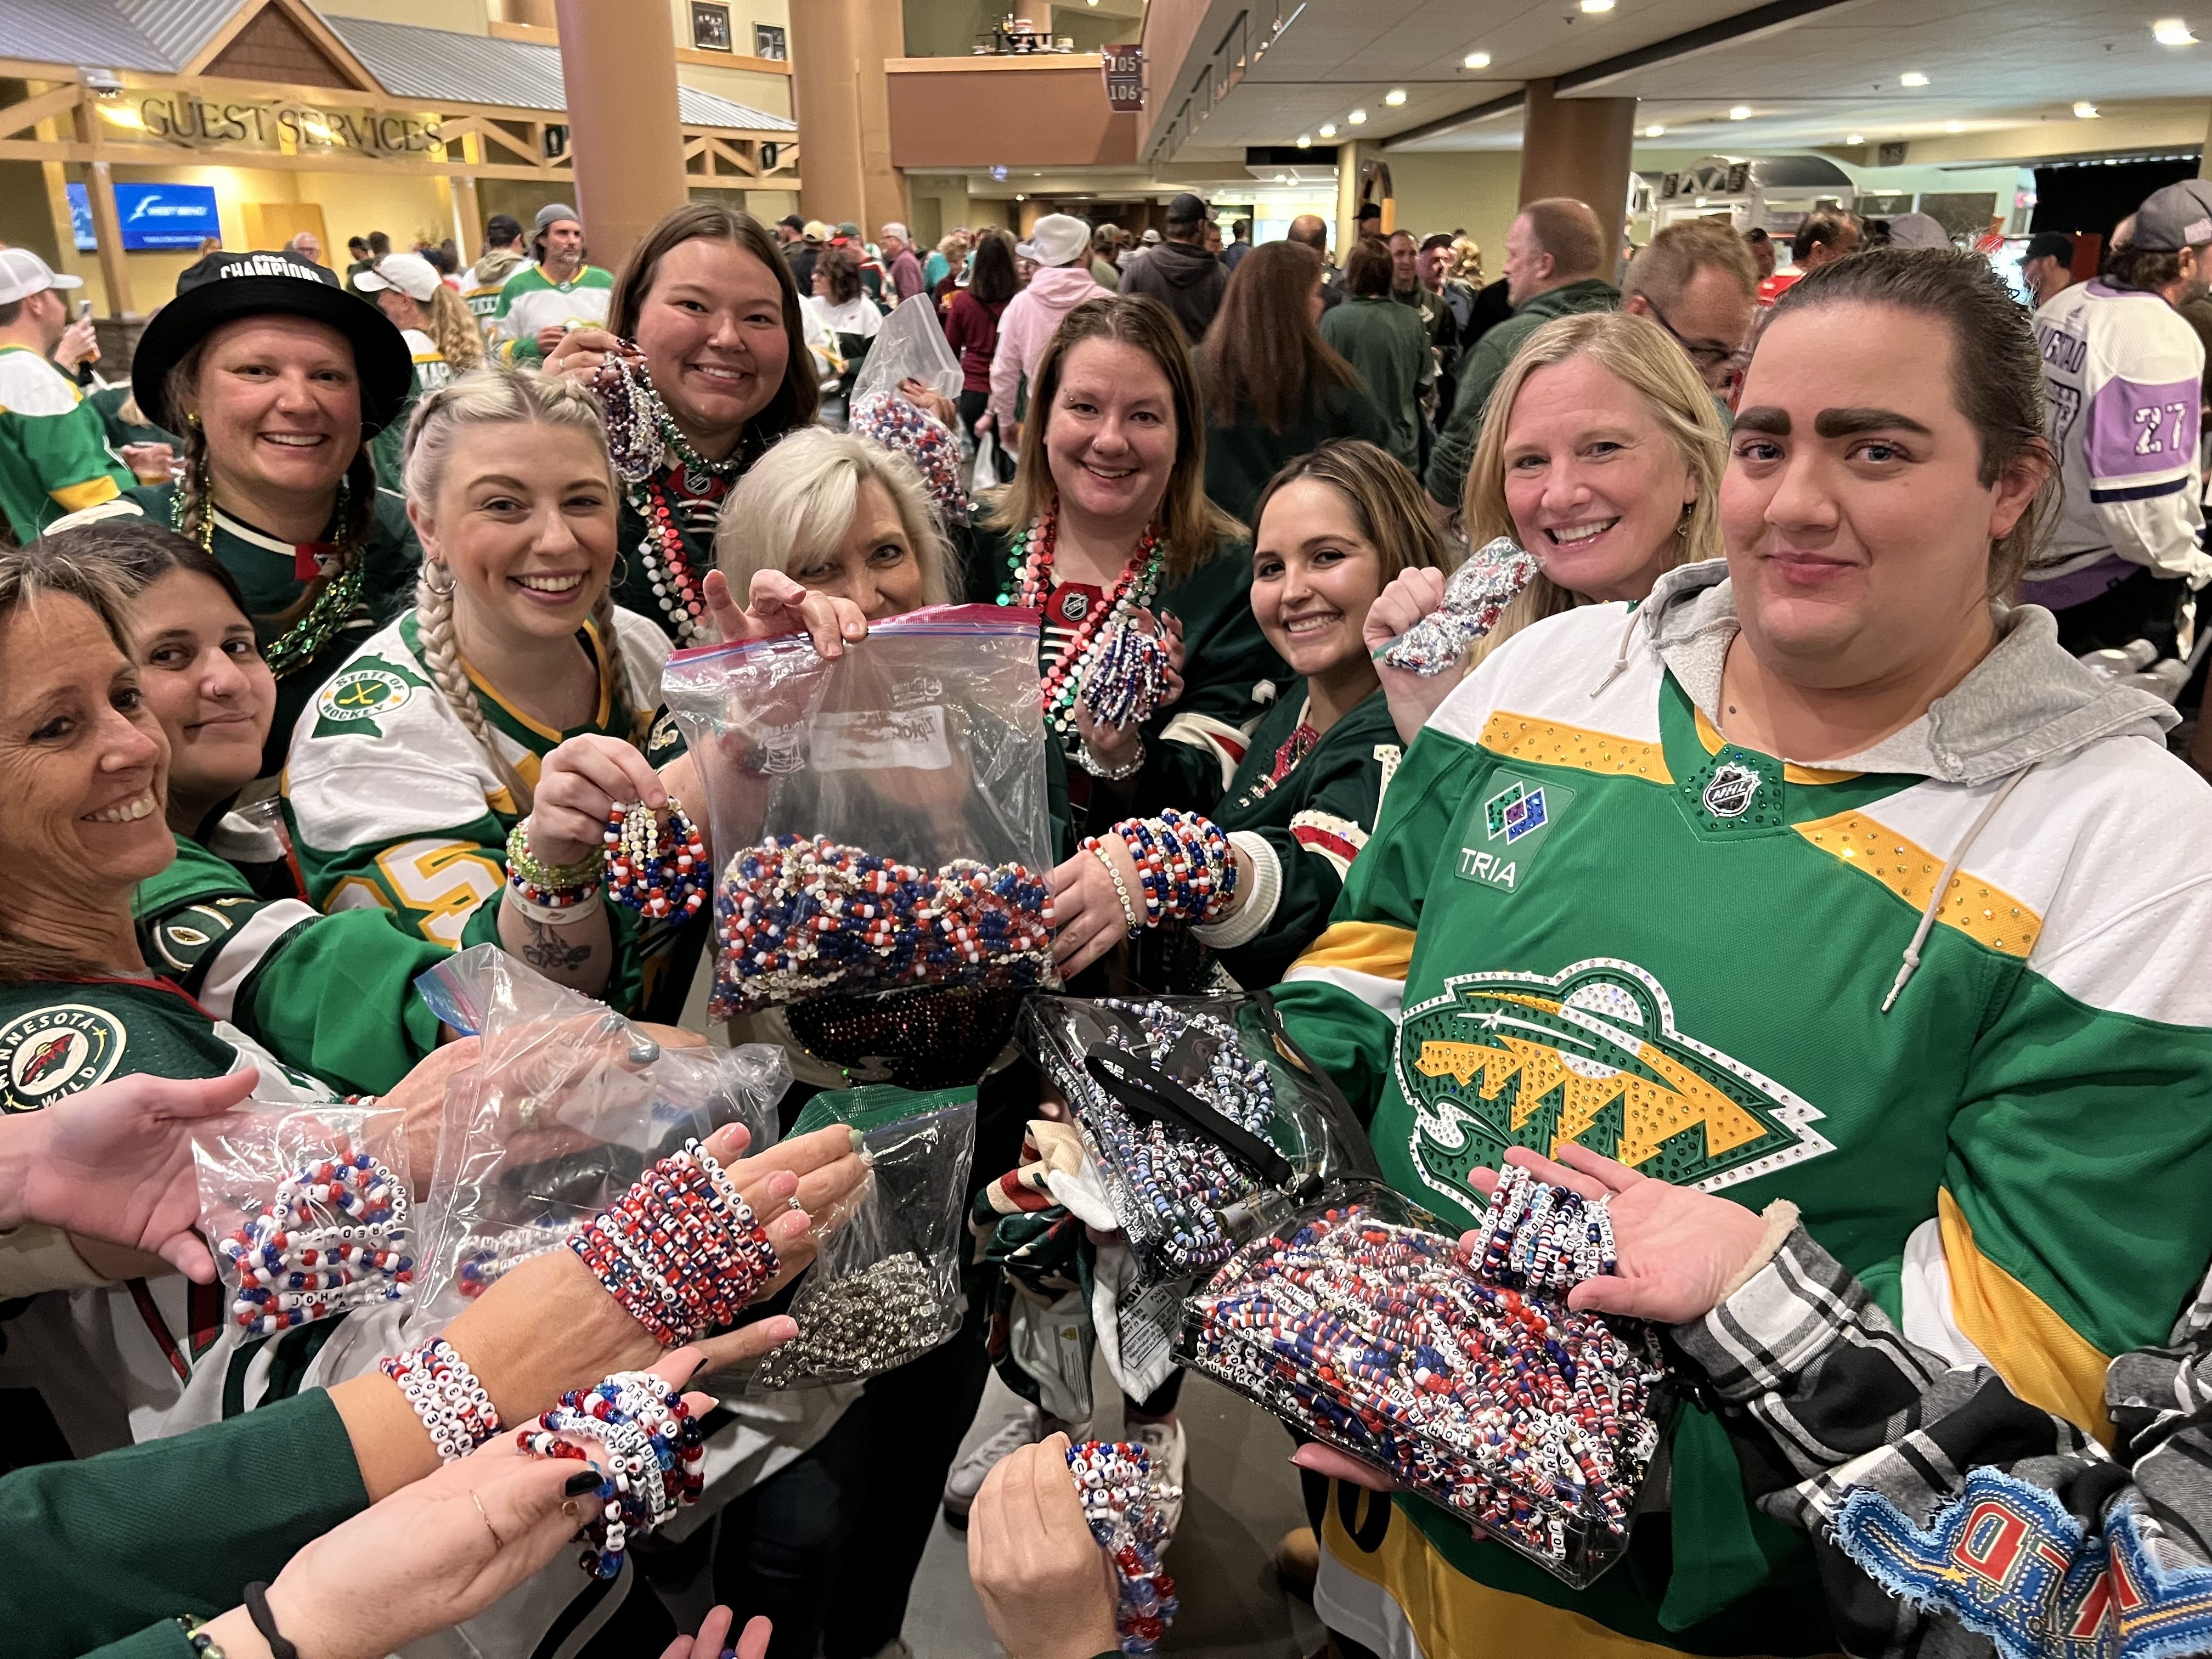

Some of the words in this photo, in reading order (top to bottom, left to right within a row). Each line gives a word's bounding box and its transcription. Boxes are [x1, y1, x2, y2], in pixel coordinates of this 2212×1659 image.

[1109, 57, 1137, 72] 105
[1109, 85, 1137, 100] 106
[140, 99, 268, 142] GUEST
[278, 109, 444, 154] SERVICES
[2135, 401, 2187, 455] 27
[336, 672, 388, 687] STATE
[390, 678, 405, 691] OF
[323, 704, 383, 719] HOCKEY
[1712, 780, 1748, 799] NHL
[1462, 848, 1516, 888] TRIA
[41, 1066, 97, 1108] WILD
[438, 1345, 493, 1414] JOHNNY
[403, 1374, 453, 1454] OREVER
